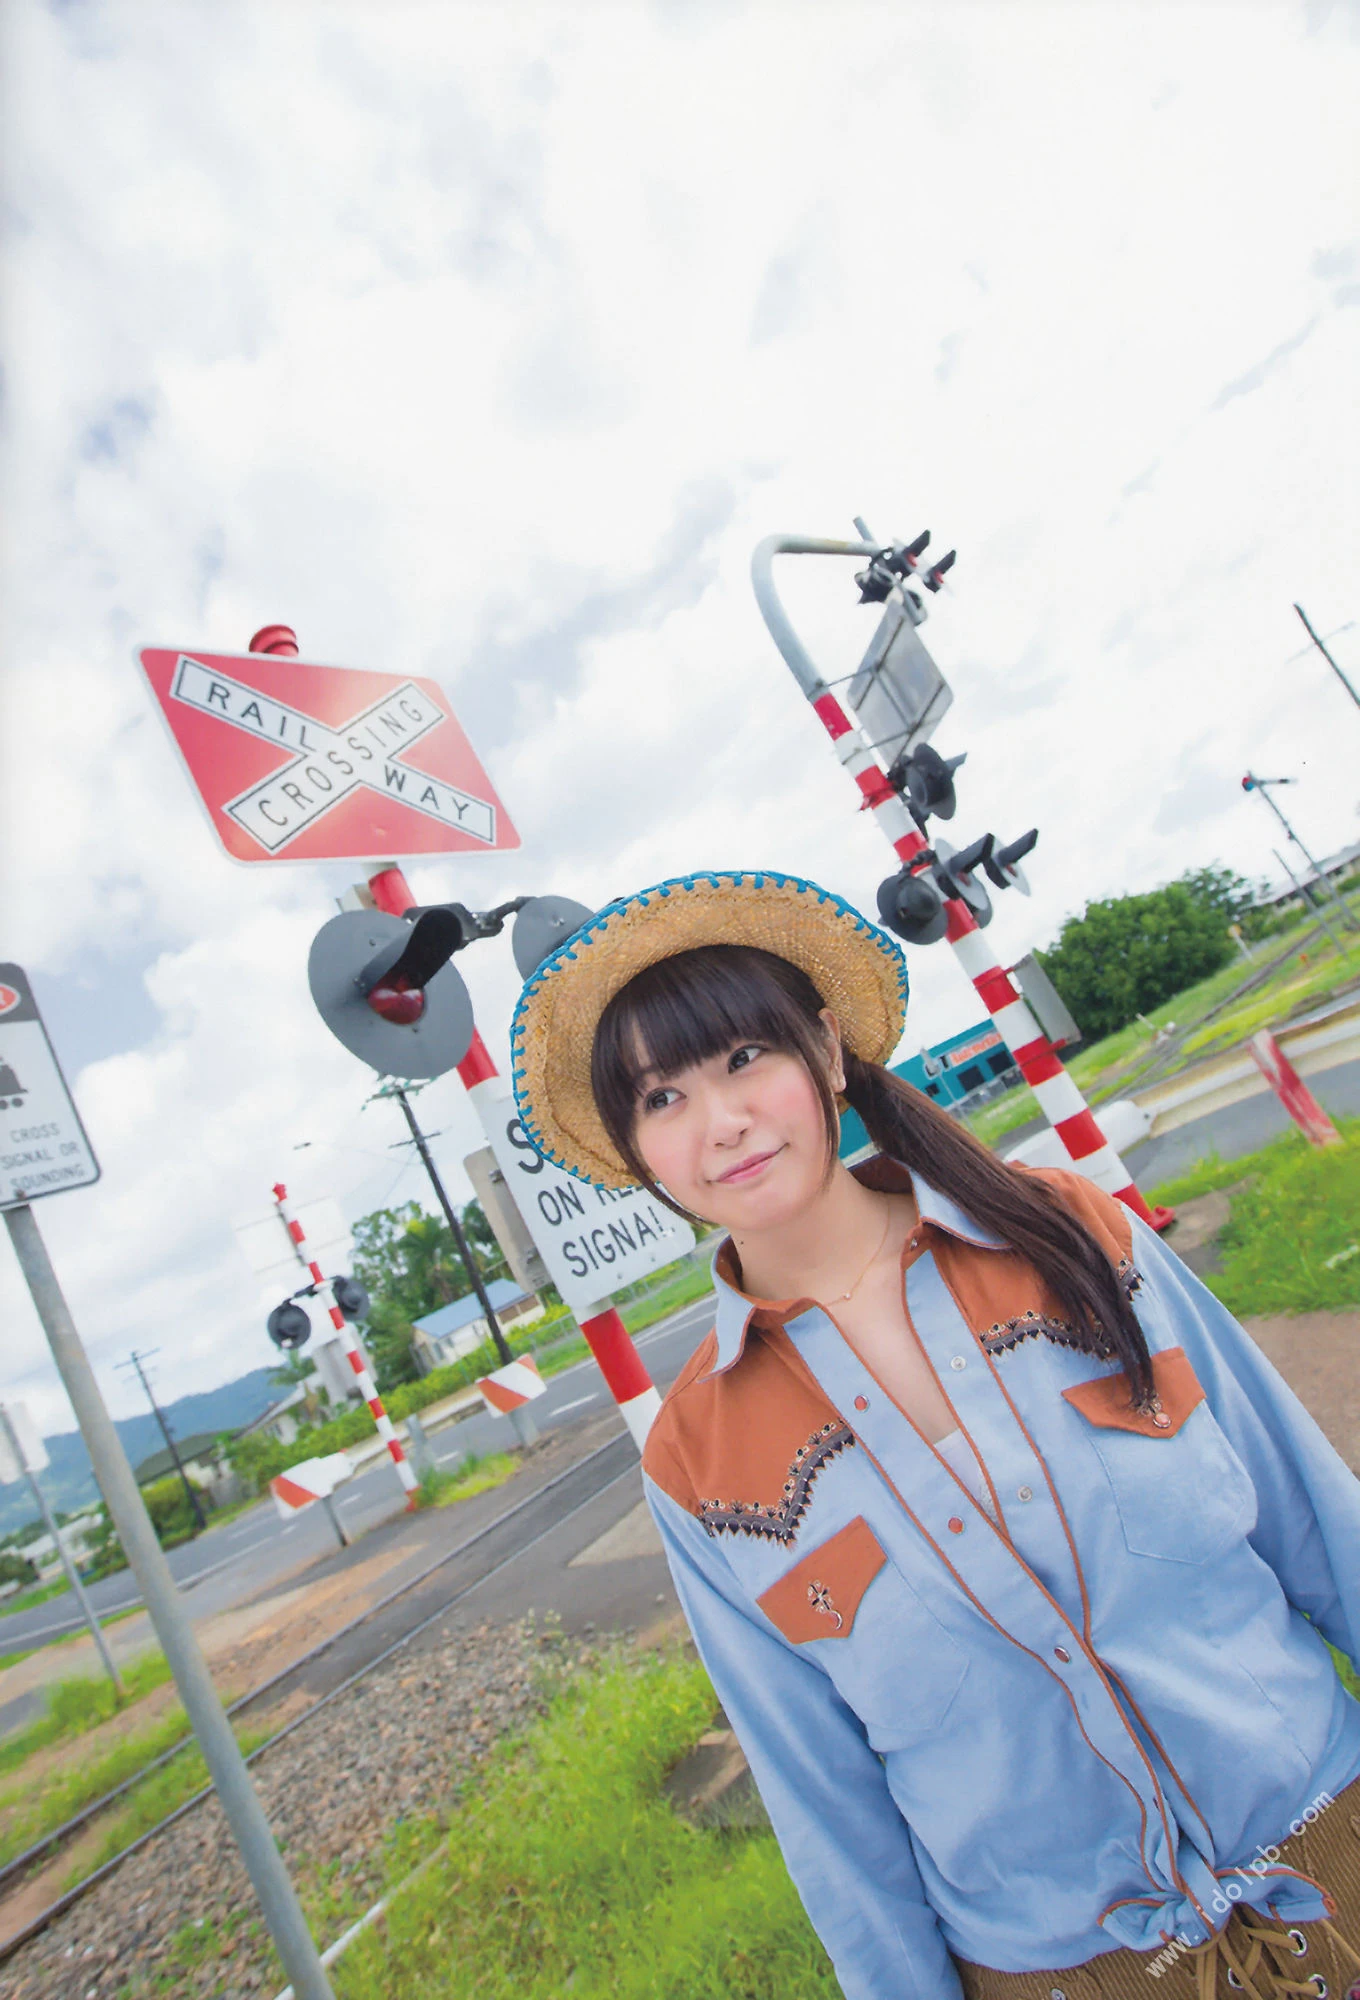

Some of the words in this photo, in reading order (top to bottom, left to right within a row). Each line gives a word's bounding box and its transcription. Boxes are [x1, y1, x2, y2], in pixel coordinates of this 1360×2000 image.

[209, 681, 317, 752] RAIL
[384, 764, 470, 821] WAY
[258, 699, 423, 827] CROSSING
[10, 1122, 60, 1143] CROSS
[0, 1149, 56, 1170] SIGNAL
[59, 1141, 80, 1156] OR
[10, 1163, 86, 1190] SOUNDING
[537, 1181, 585, 1226] ON
